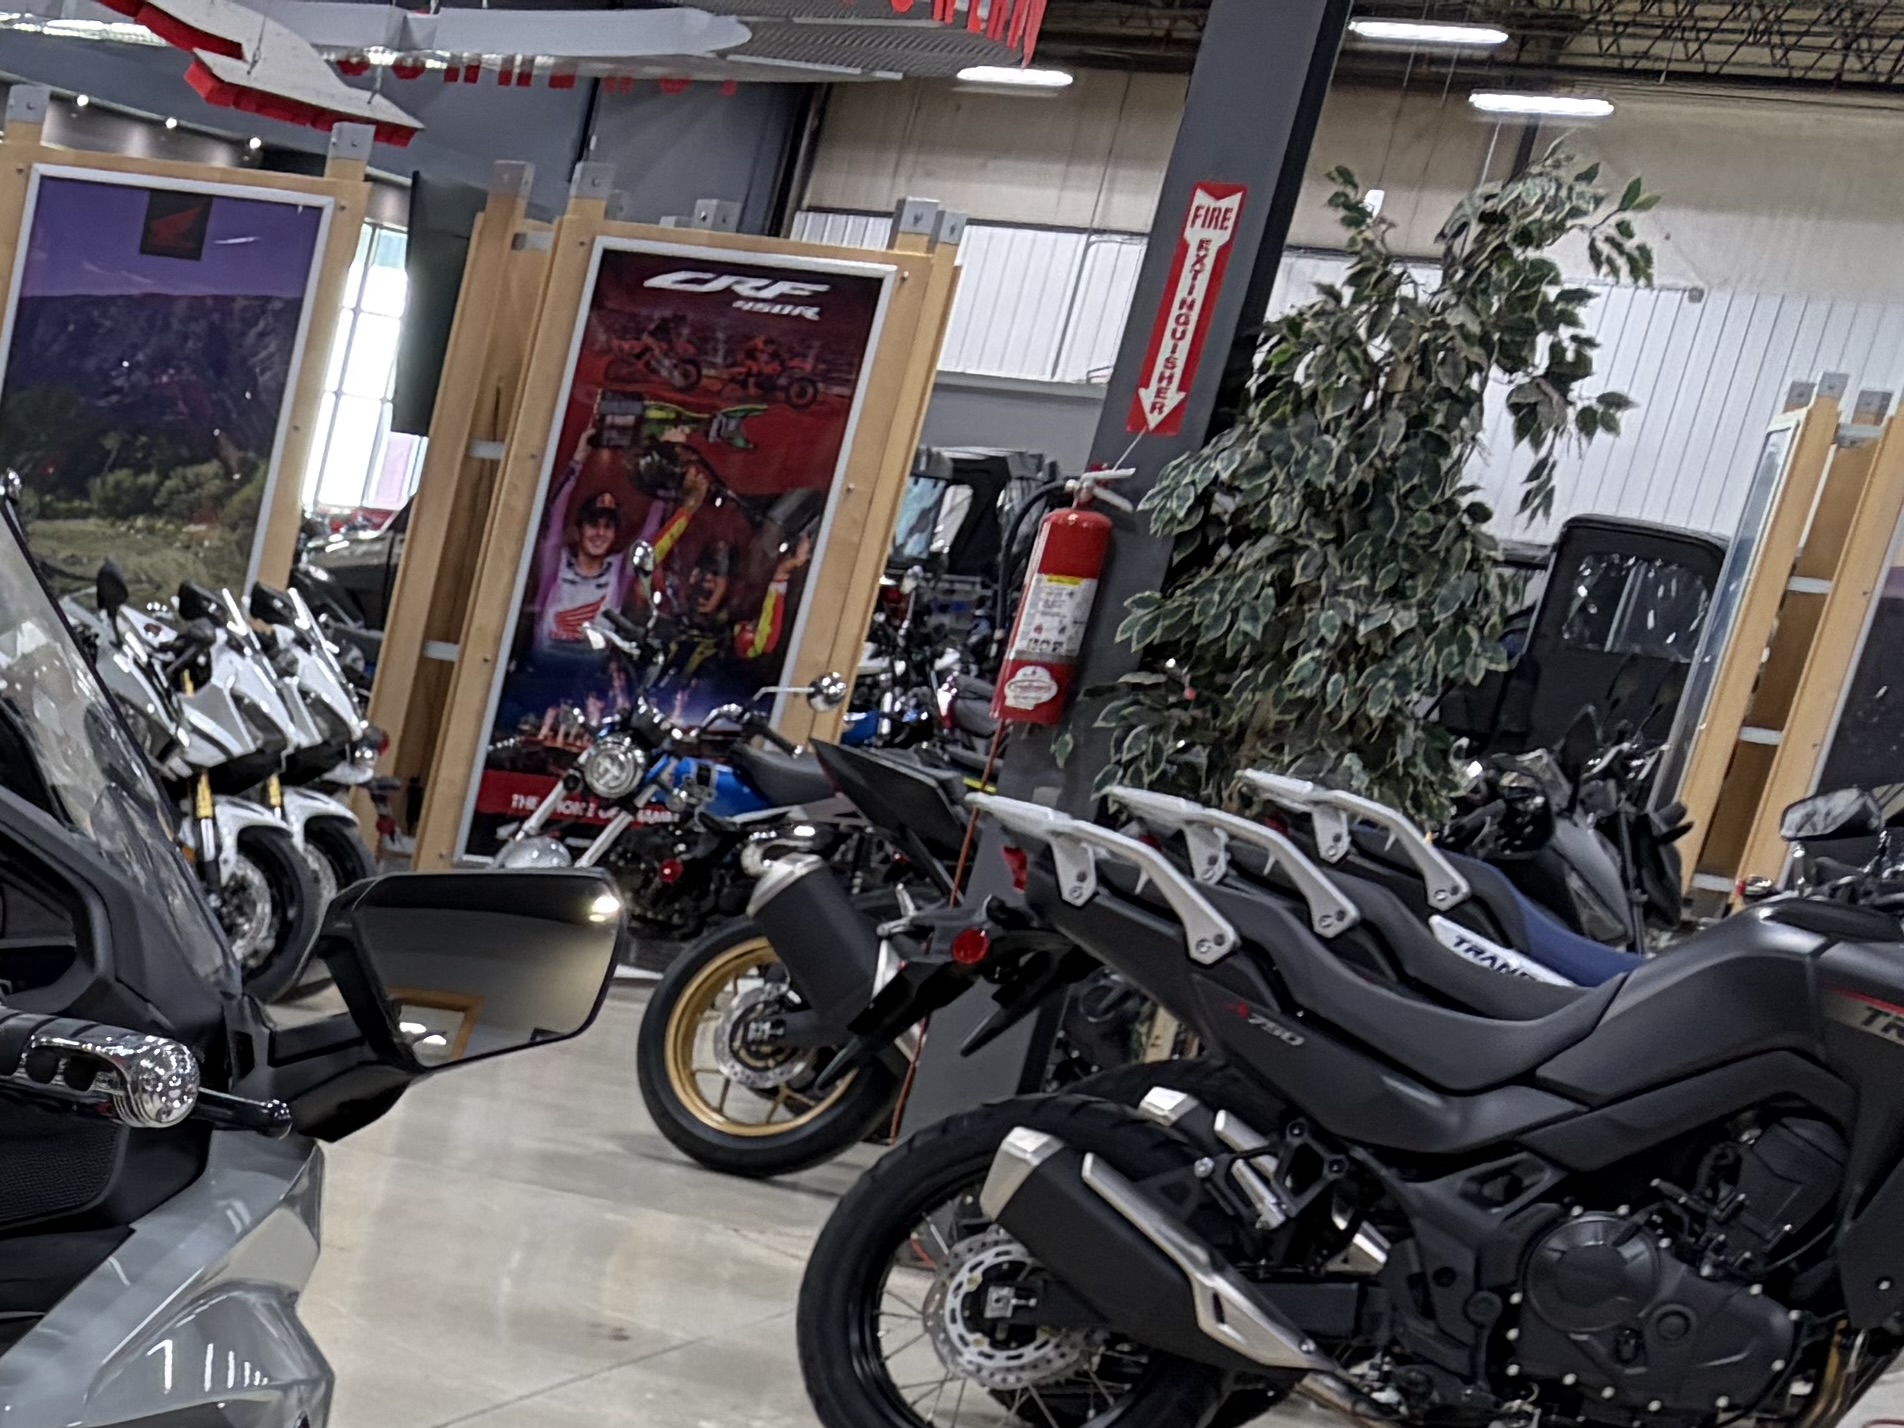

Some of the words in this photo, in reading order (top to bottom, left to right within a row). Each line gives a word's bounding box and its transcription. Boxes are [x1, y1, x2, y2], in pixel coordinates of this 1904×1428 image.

[1190, 204, 1234, 231] FIRE
[643, 270, 831, 300] CRF
[1149, 238, 1212, 416] EXTINGUISHER
